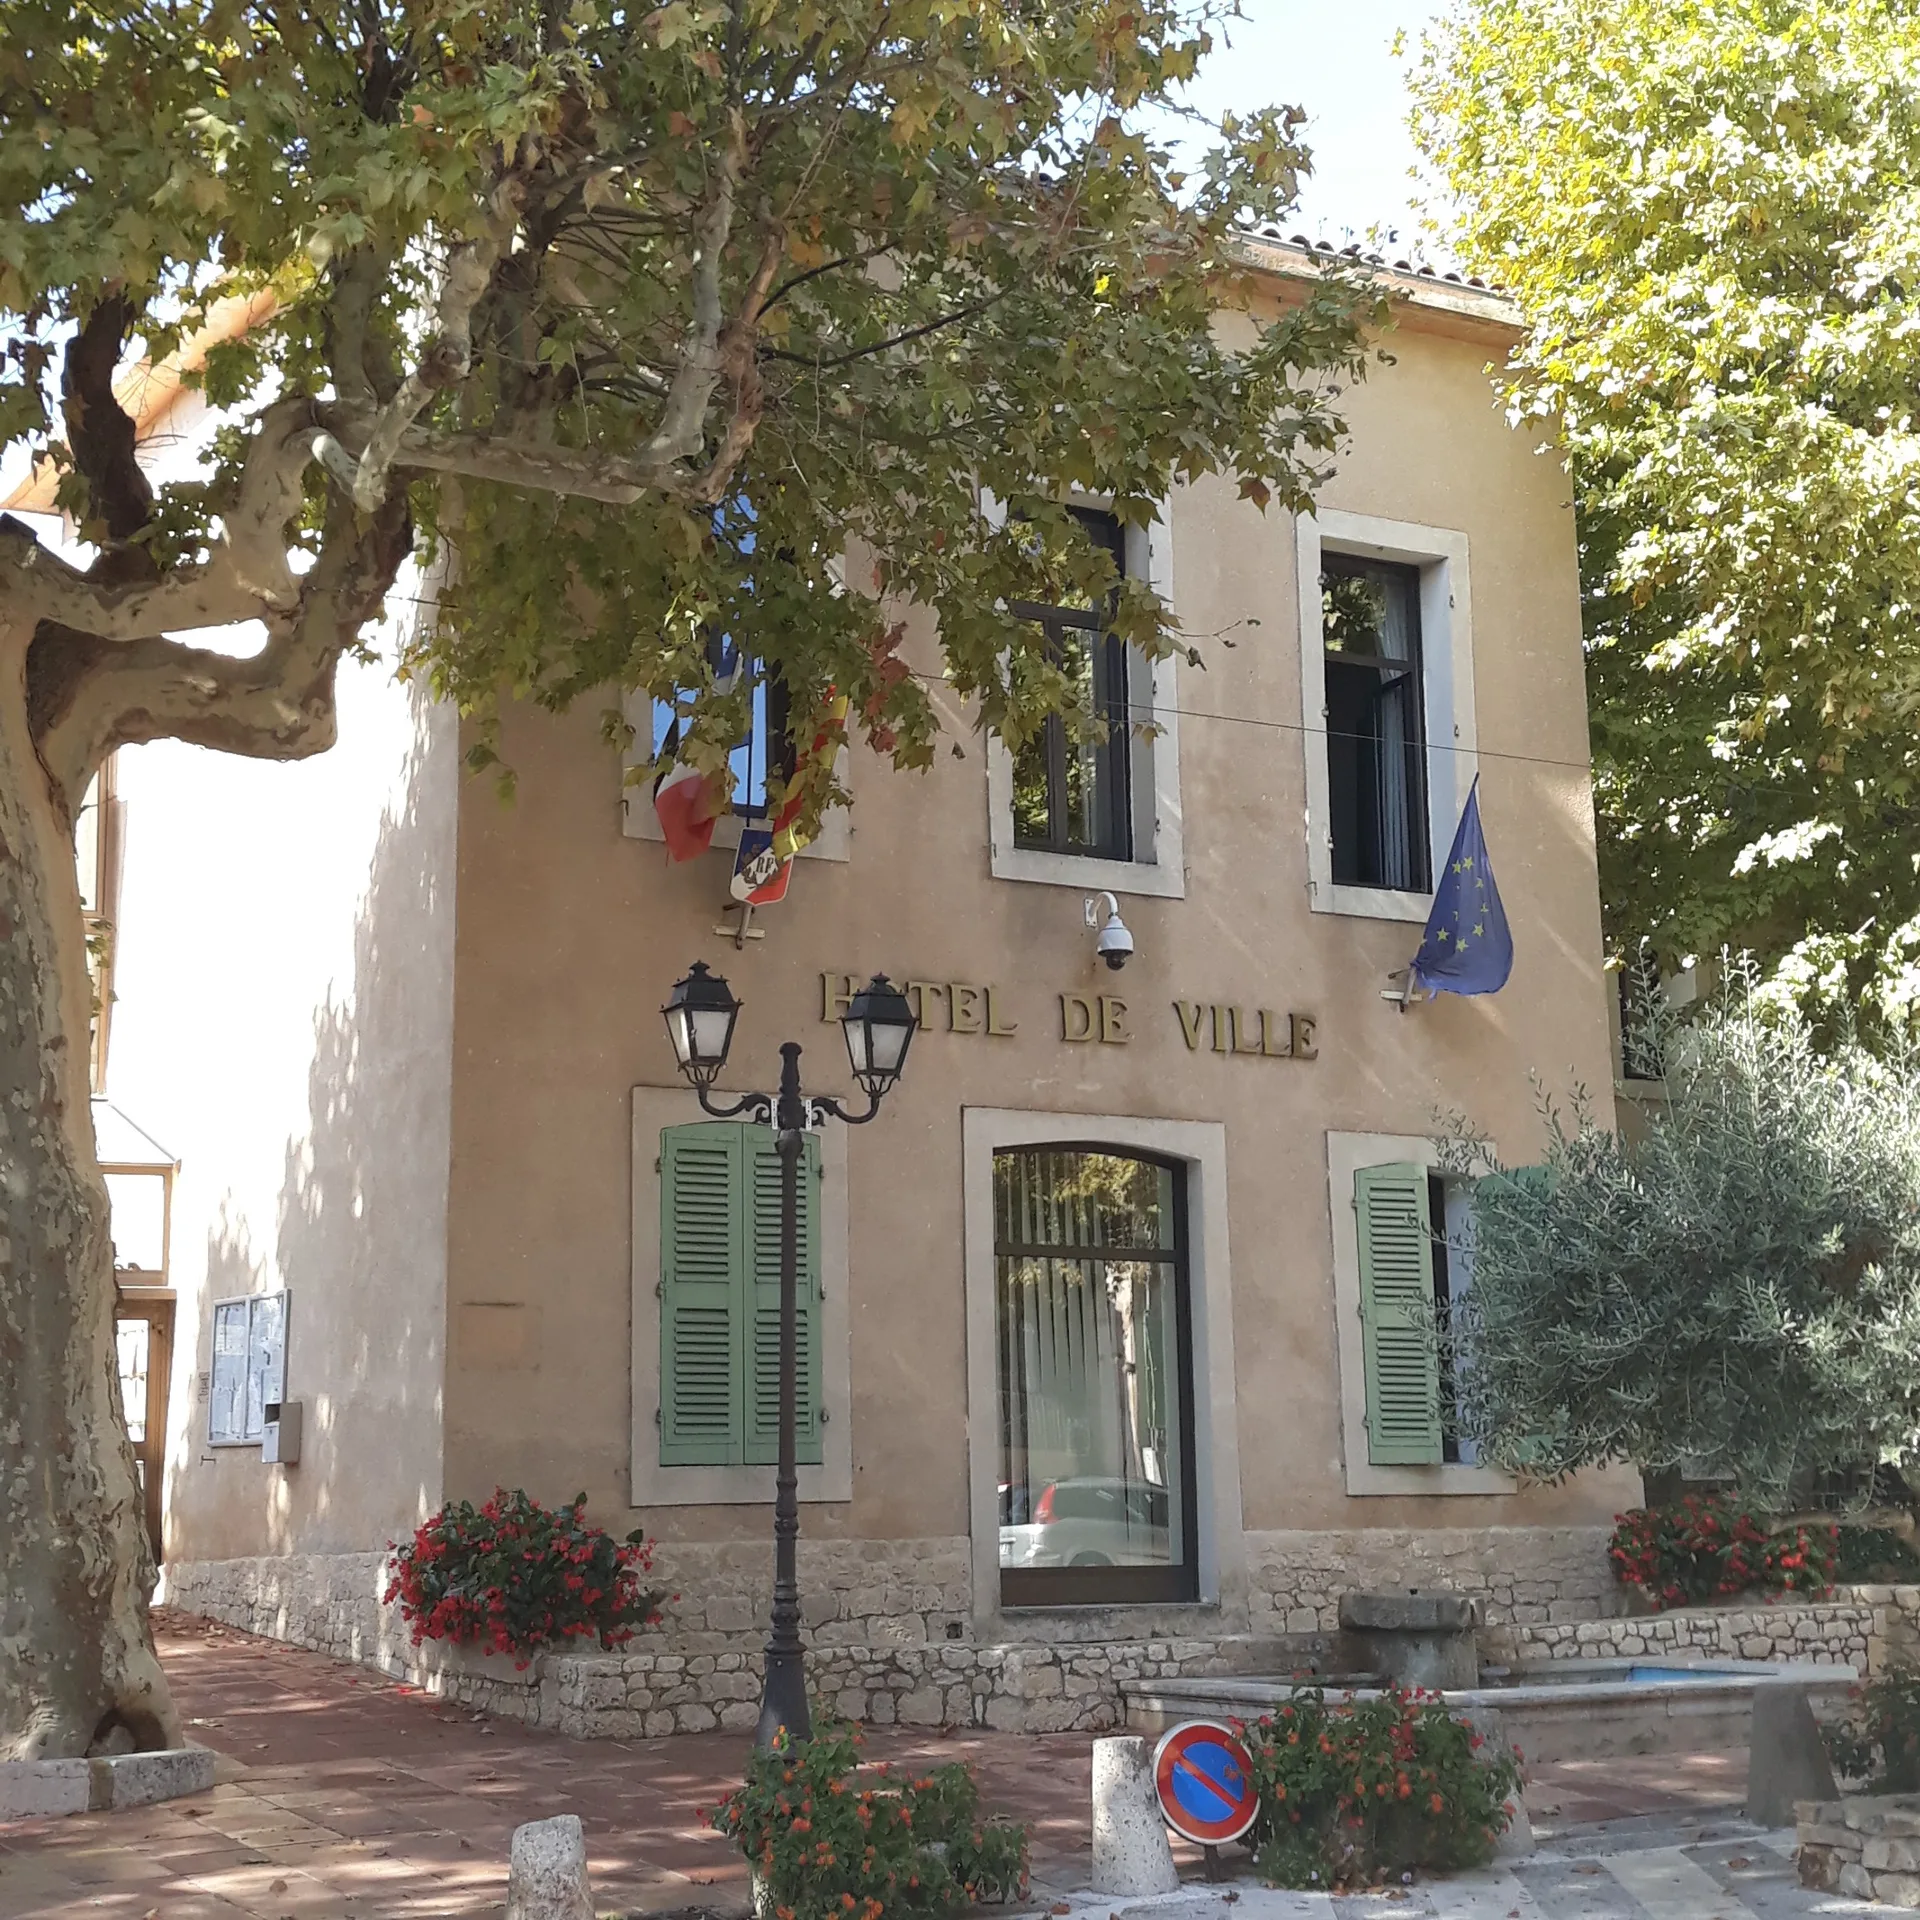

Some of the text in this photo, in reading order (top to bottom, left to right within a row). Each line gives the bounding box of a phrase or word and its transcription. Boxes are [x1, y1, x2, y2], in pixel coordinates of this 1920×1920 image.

[820, 973, 1319, 1060] HTEL DE VILLE
